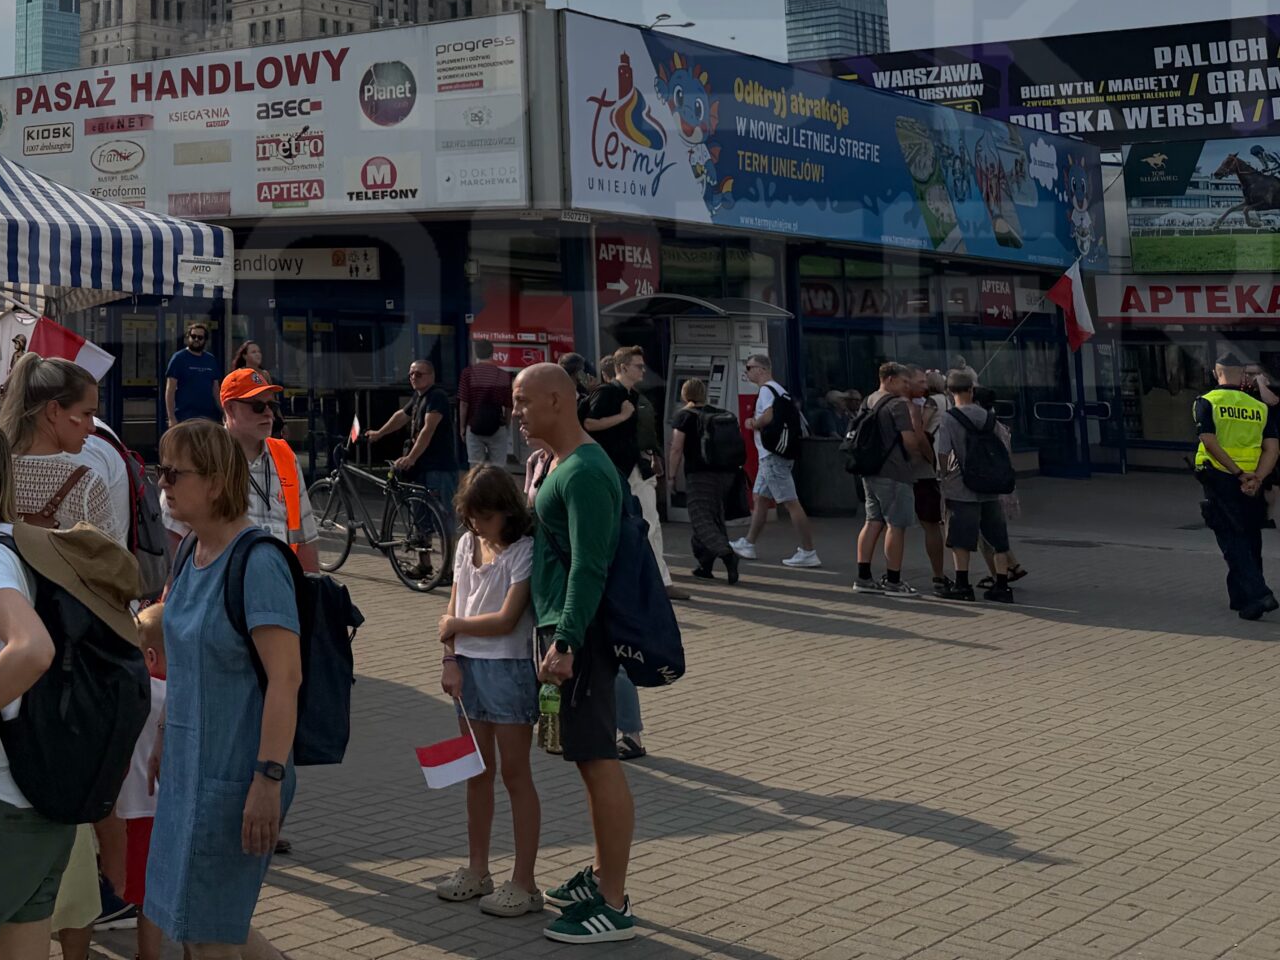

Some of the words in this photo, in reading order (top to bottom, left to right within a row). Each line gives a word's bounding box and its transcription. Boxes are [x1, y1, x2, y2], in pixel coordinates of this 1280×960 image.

[435, 36, 516, 57] progress
[1153, 36, 1269, 70] PALUCH
[15, 70, 116, 115] PASAŻ
[130, 47, 350, 103] HANDLOWY
[872, 62, 983, 89] WARSZAWA
[364, 80, 412, 101] Planet
[919, 83, 984, 100] URSYNÓW
[1020, 85, 1055, 99] BUGI
[1058, 81, 1095, 96] WTH
[1107, 75, 1180, 93] MACIĘTY
[734, 76, 787, 119] Odkryj
[790, 92, 850, 130] atrakcje
[1009, 109, 1115, 134] POLSKA
[1122, 100, 1245, 130] WERSJA
[26, 126, 72, 140] KIOSK
[586, 88, 678, 197] termy
[735, 116, 747, 136] W
[749, 118, 790, 145] NOWEJ
[792, 127, 837, 154] LETNIEJ
[839, 137, 880, 163] STREFIE
[257, 137, 323, 157] metro
[367, 164, 392, 185] M
[737, 150, 769, 174] TERM
[771, 155, 825, 184] UNIEJÓW!
[96, 185, 146, 198] Fotoforma
[259, 182, 322, 200] APTEKA
[459, 177, 518, 187] MARCHEWKA
[587, 177, 647, 196] UNIEJÓW
[347, 189, 418, 202] TELEFONY
[599, 243, 652, 265] APTEKA
[234, 255, 304, 275] andlowy
[981, 279, 1011, 295] APTEKA
[492, 351, 509, 363] ety
[1219, 406, 1262, 422] POLICJA
[613, 644, 645, 664] KIA
